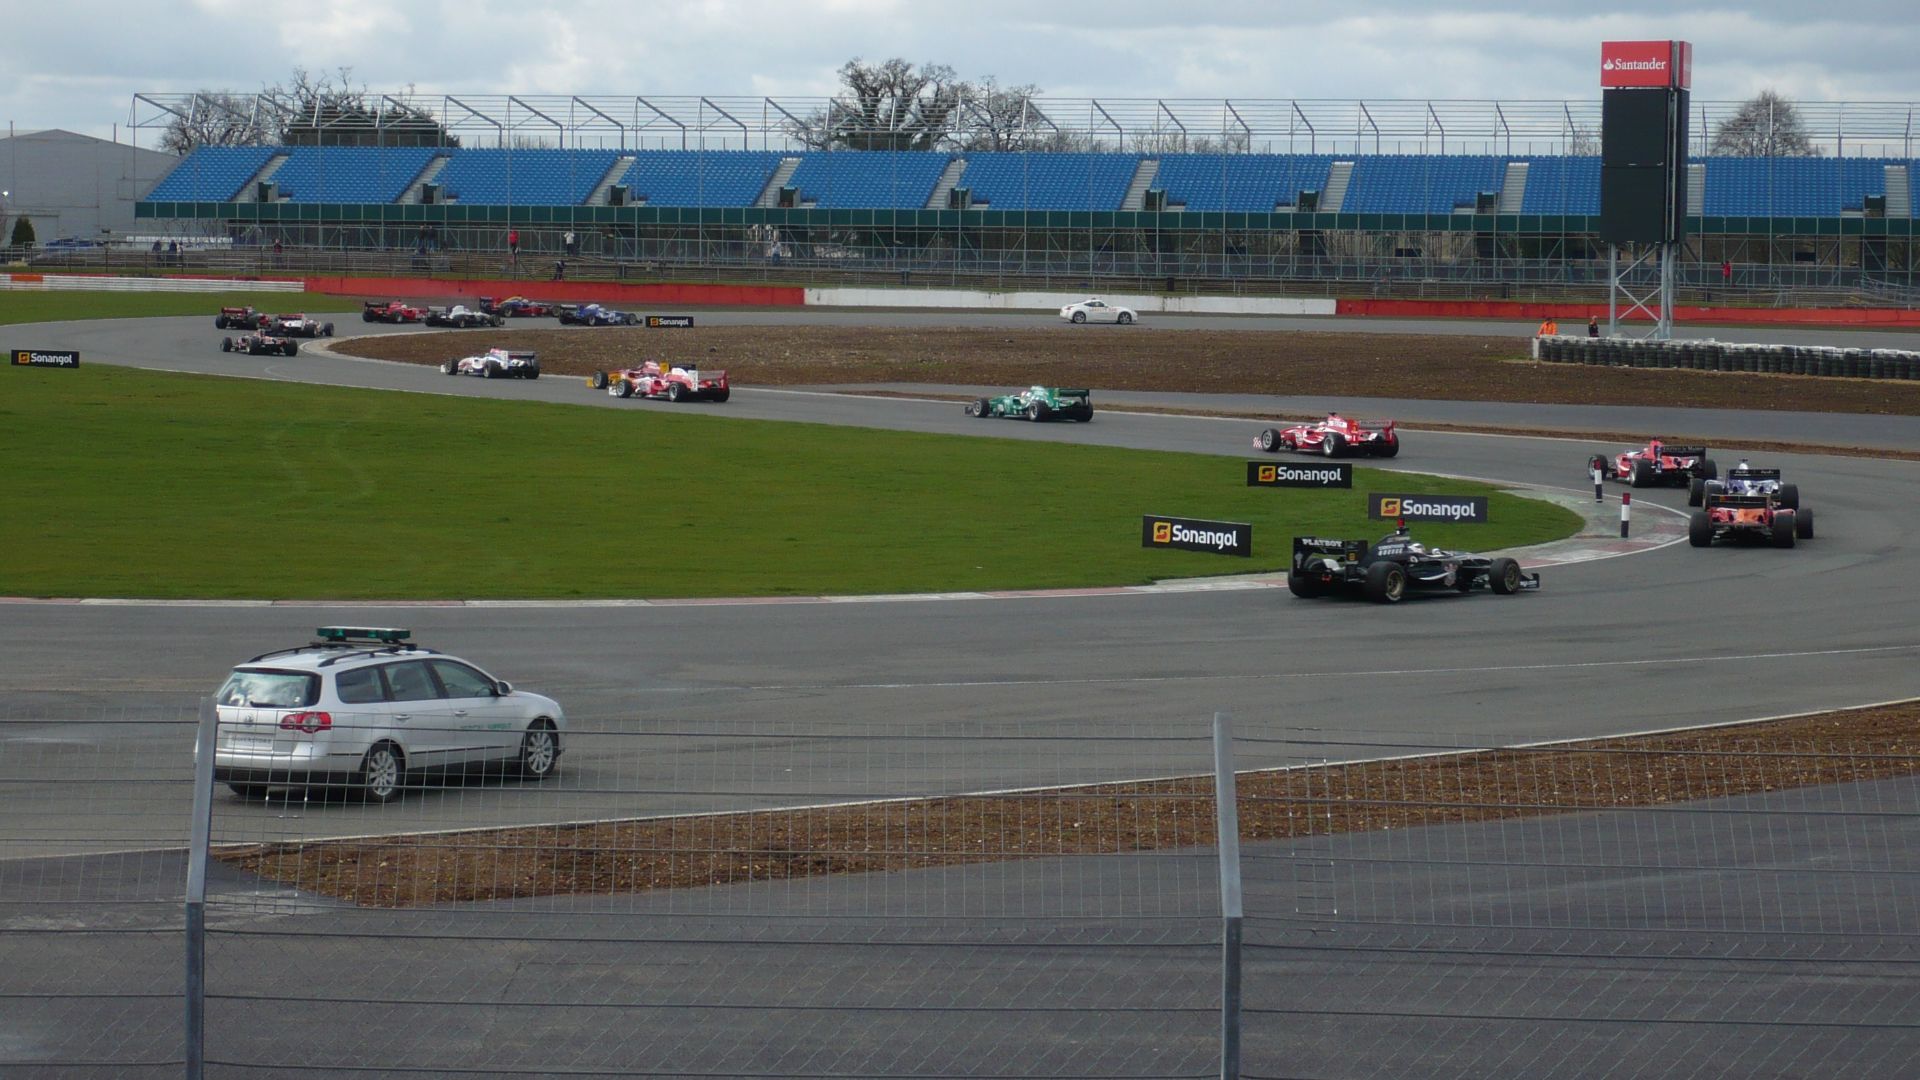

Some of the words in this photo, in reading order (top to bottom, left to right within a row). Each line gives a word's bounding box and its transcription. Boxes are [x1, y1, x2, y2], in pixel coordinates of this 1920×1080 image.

[1615, 57, 1666, 70] Santander
[30, 353, 72, 365] Sonangol
[1277, 466, 1342, 484] Sonangol
[1402, 499, 1476, 520] Sonangol
[1172, 524, 1238, 550] Sonangol
[1302, 538, 1343, 548] PLAYBOY
